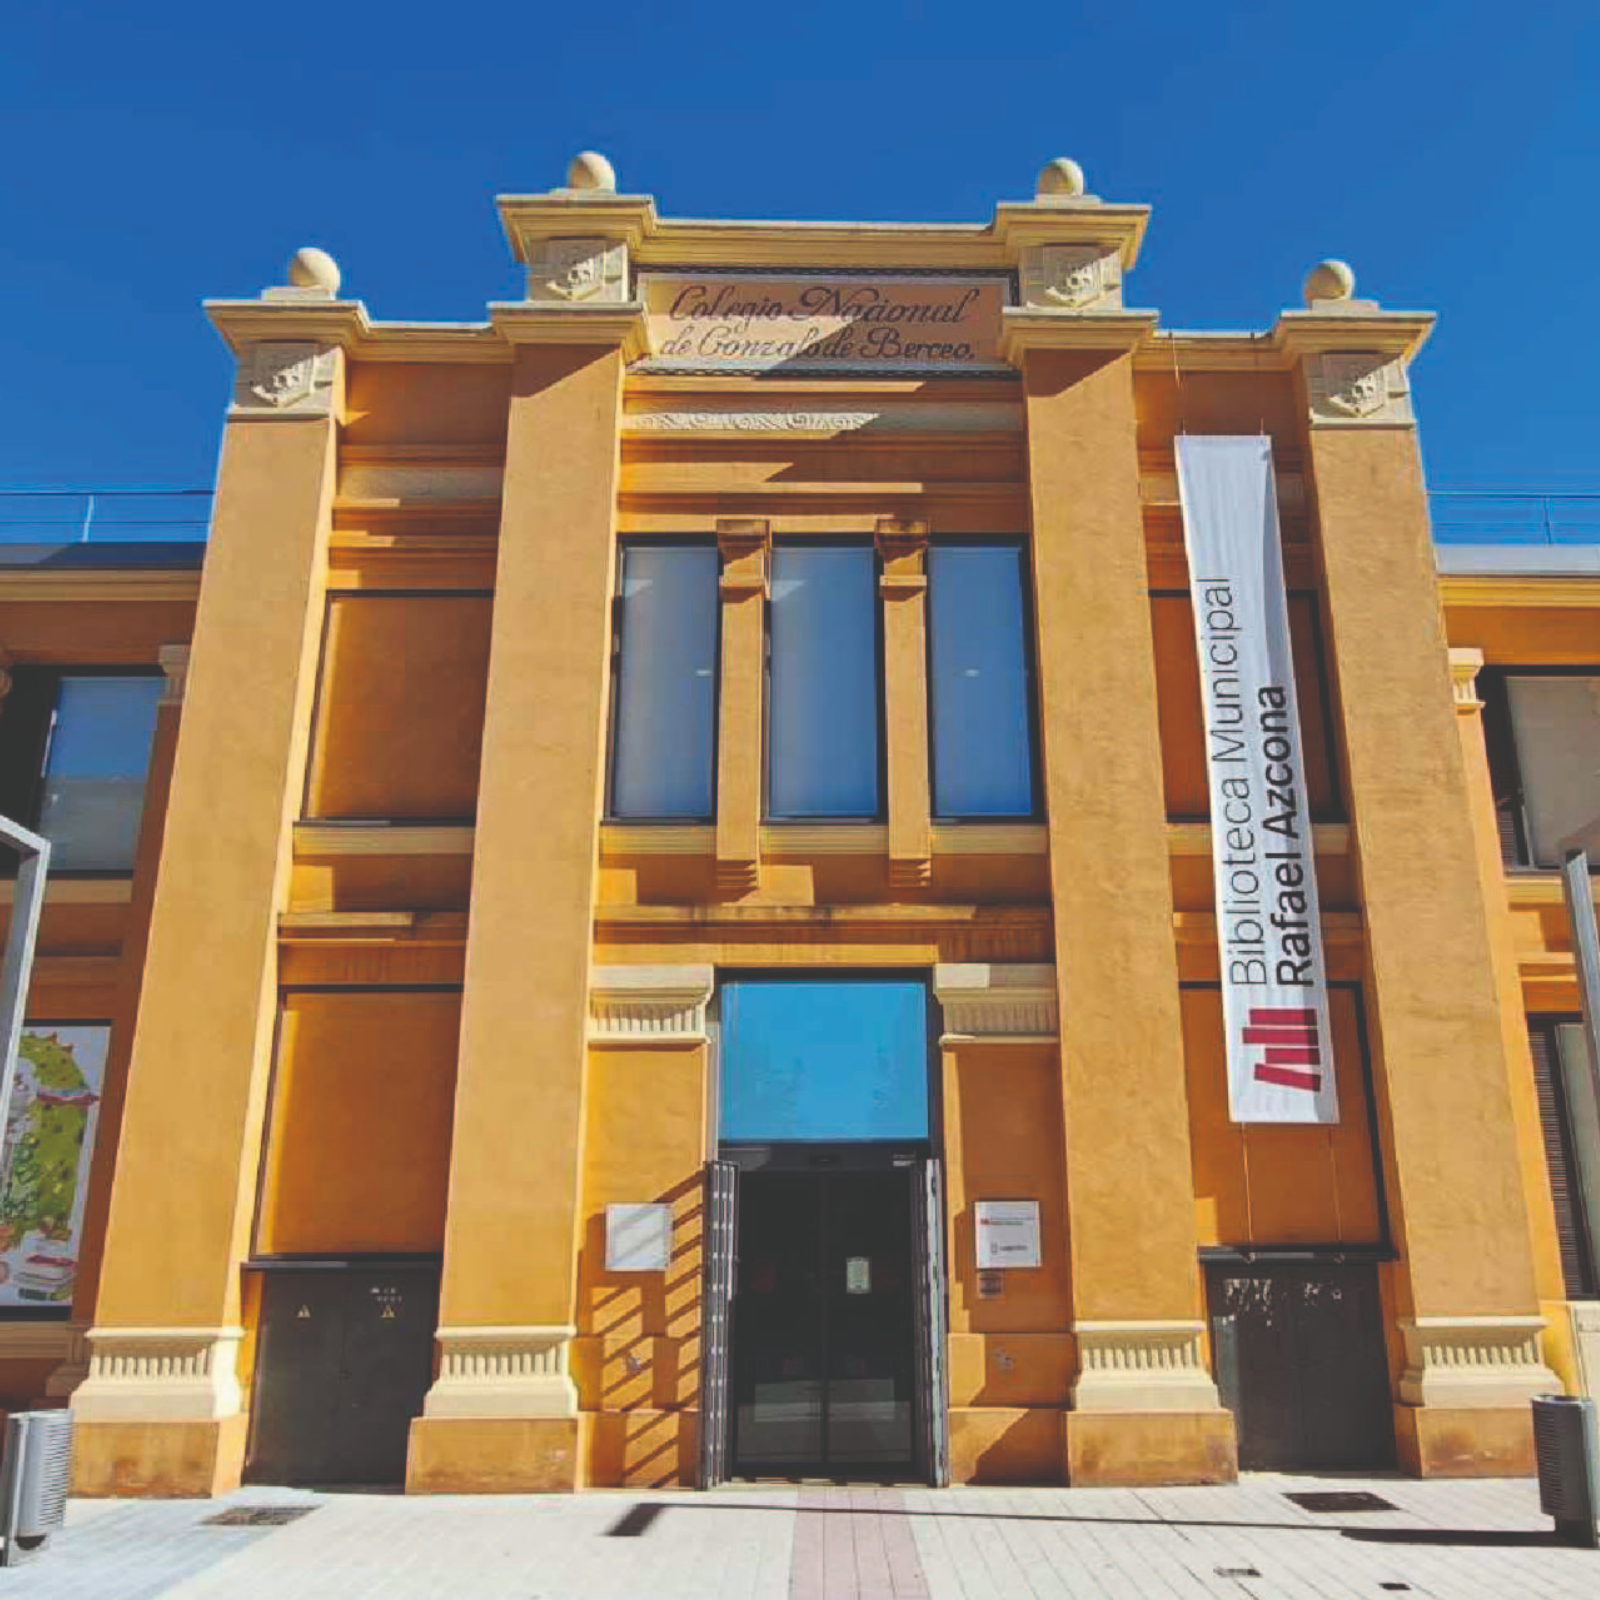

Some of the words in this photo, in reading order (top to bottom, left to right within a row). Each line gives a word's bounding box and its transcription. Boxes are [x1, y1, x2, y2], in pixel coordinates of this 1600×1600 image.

[660, 324, 693, 355] de
[698, 325, 822, 357] Gonzalo
[823, 327, 854, 357] de
[669, 285, 783, 333] Colegio
[787, 286, 980, 323] Nacional
[1195, 578, 1248, 762] Municipal
[1258, 686, 1299, 839] Azcona
[1221, 778, 1268, 985] Biblioteca
[1265, 852, 1314, 987] Rafael
